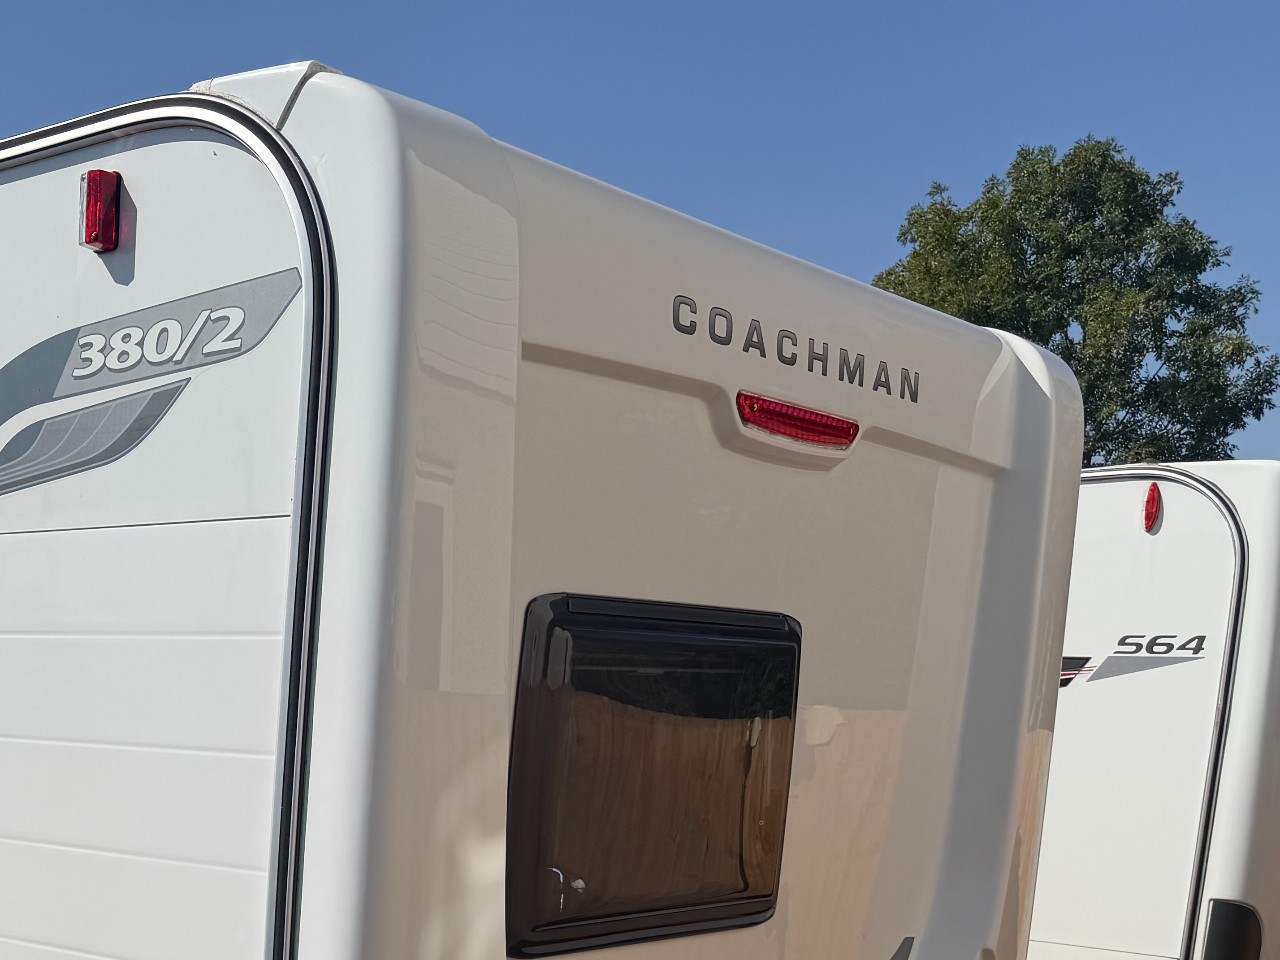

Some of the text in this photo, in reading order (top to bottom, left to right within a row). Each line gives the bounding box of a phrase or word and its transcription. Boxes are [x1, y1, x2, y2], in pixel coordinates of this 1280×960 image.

[72, 306, 246, 380] 380/2
[672, 294, 920, 404] COACHMAN
[1112, 634, 1207, 655] S64
